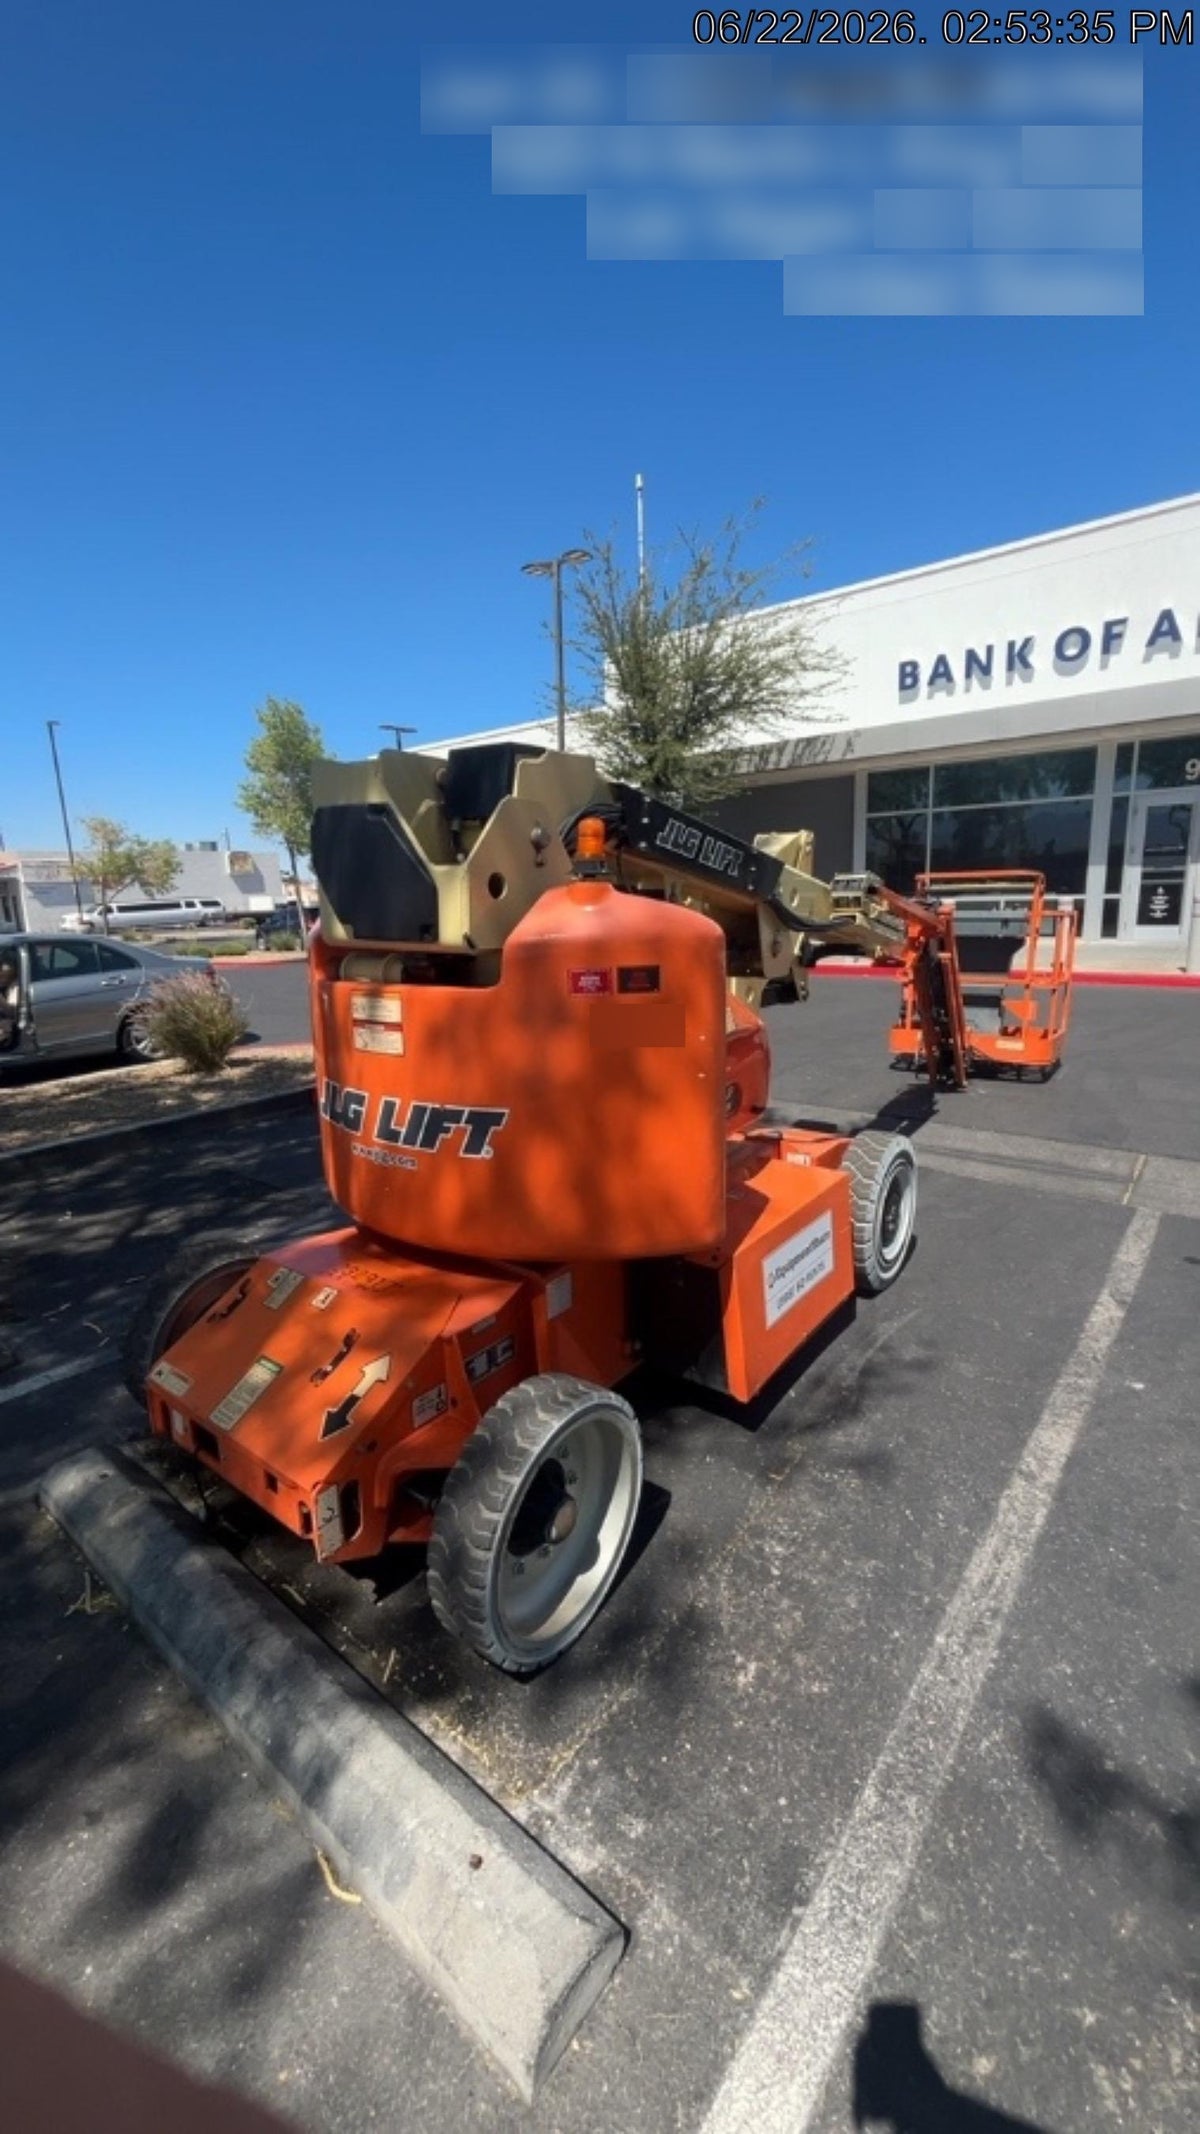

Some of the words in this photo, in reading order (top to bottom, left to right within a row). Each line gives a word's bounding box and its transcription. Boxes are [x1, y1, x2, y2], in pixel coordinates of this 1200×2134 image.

[898, 635, 1034, 691] BANK
[1054, 617, 1128, 662] OF
[1145, 608, 1200, 648] A
[656, 818, 702, 859] JLG
[699, 836, 744, 877] LIFT
[320, 1078, 369, 1136] JLG
[373, 1096, 510, 1158] LIFT
